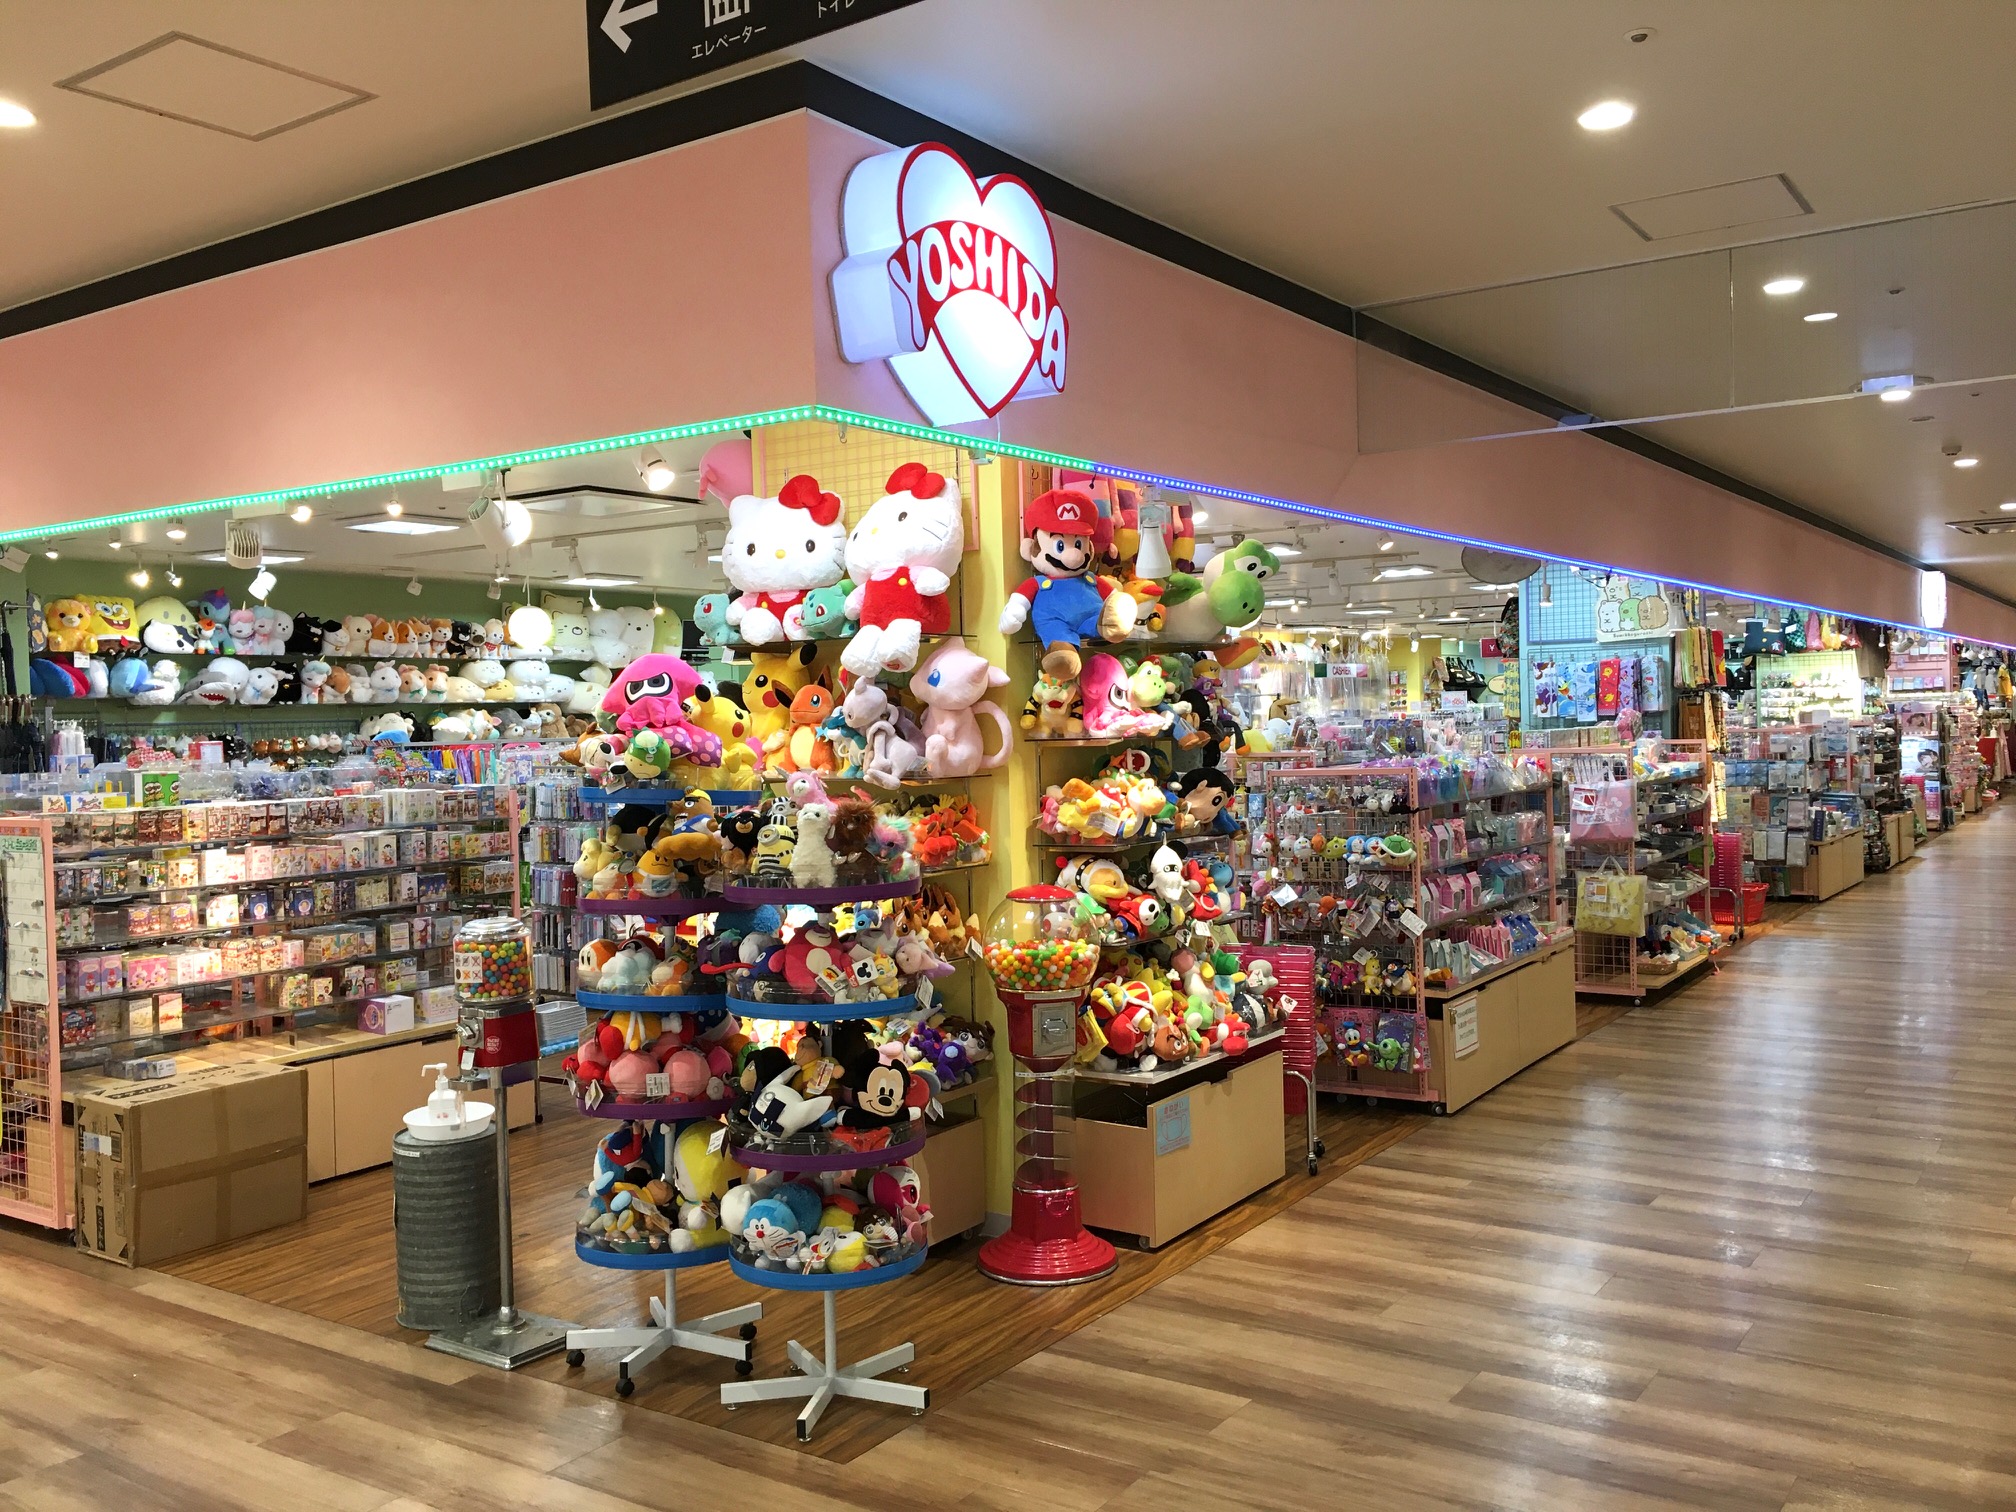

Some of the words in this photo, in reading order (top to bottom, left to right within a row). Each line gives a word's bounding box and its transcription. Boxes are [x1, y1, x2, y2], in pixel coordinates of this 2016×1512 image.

[691, 25, 767, 59] エレベーター
[889, 221, 1067, 389] YOSHIDA
[1059, 505, 1079, 519] M
[1332, 665, 1352, 675] CASHIER
